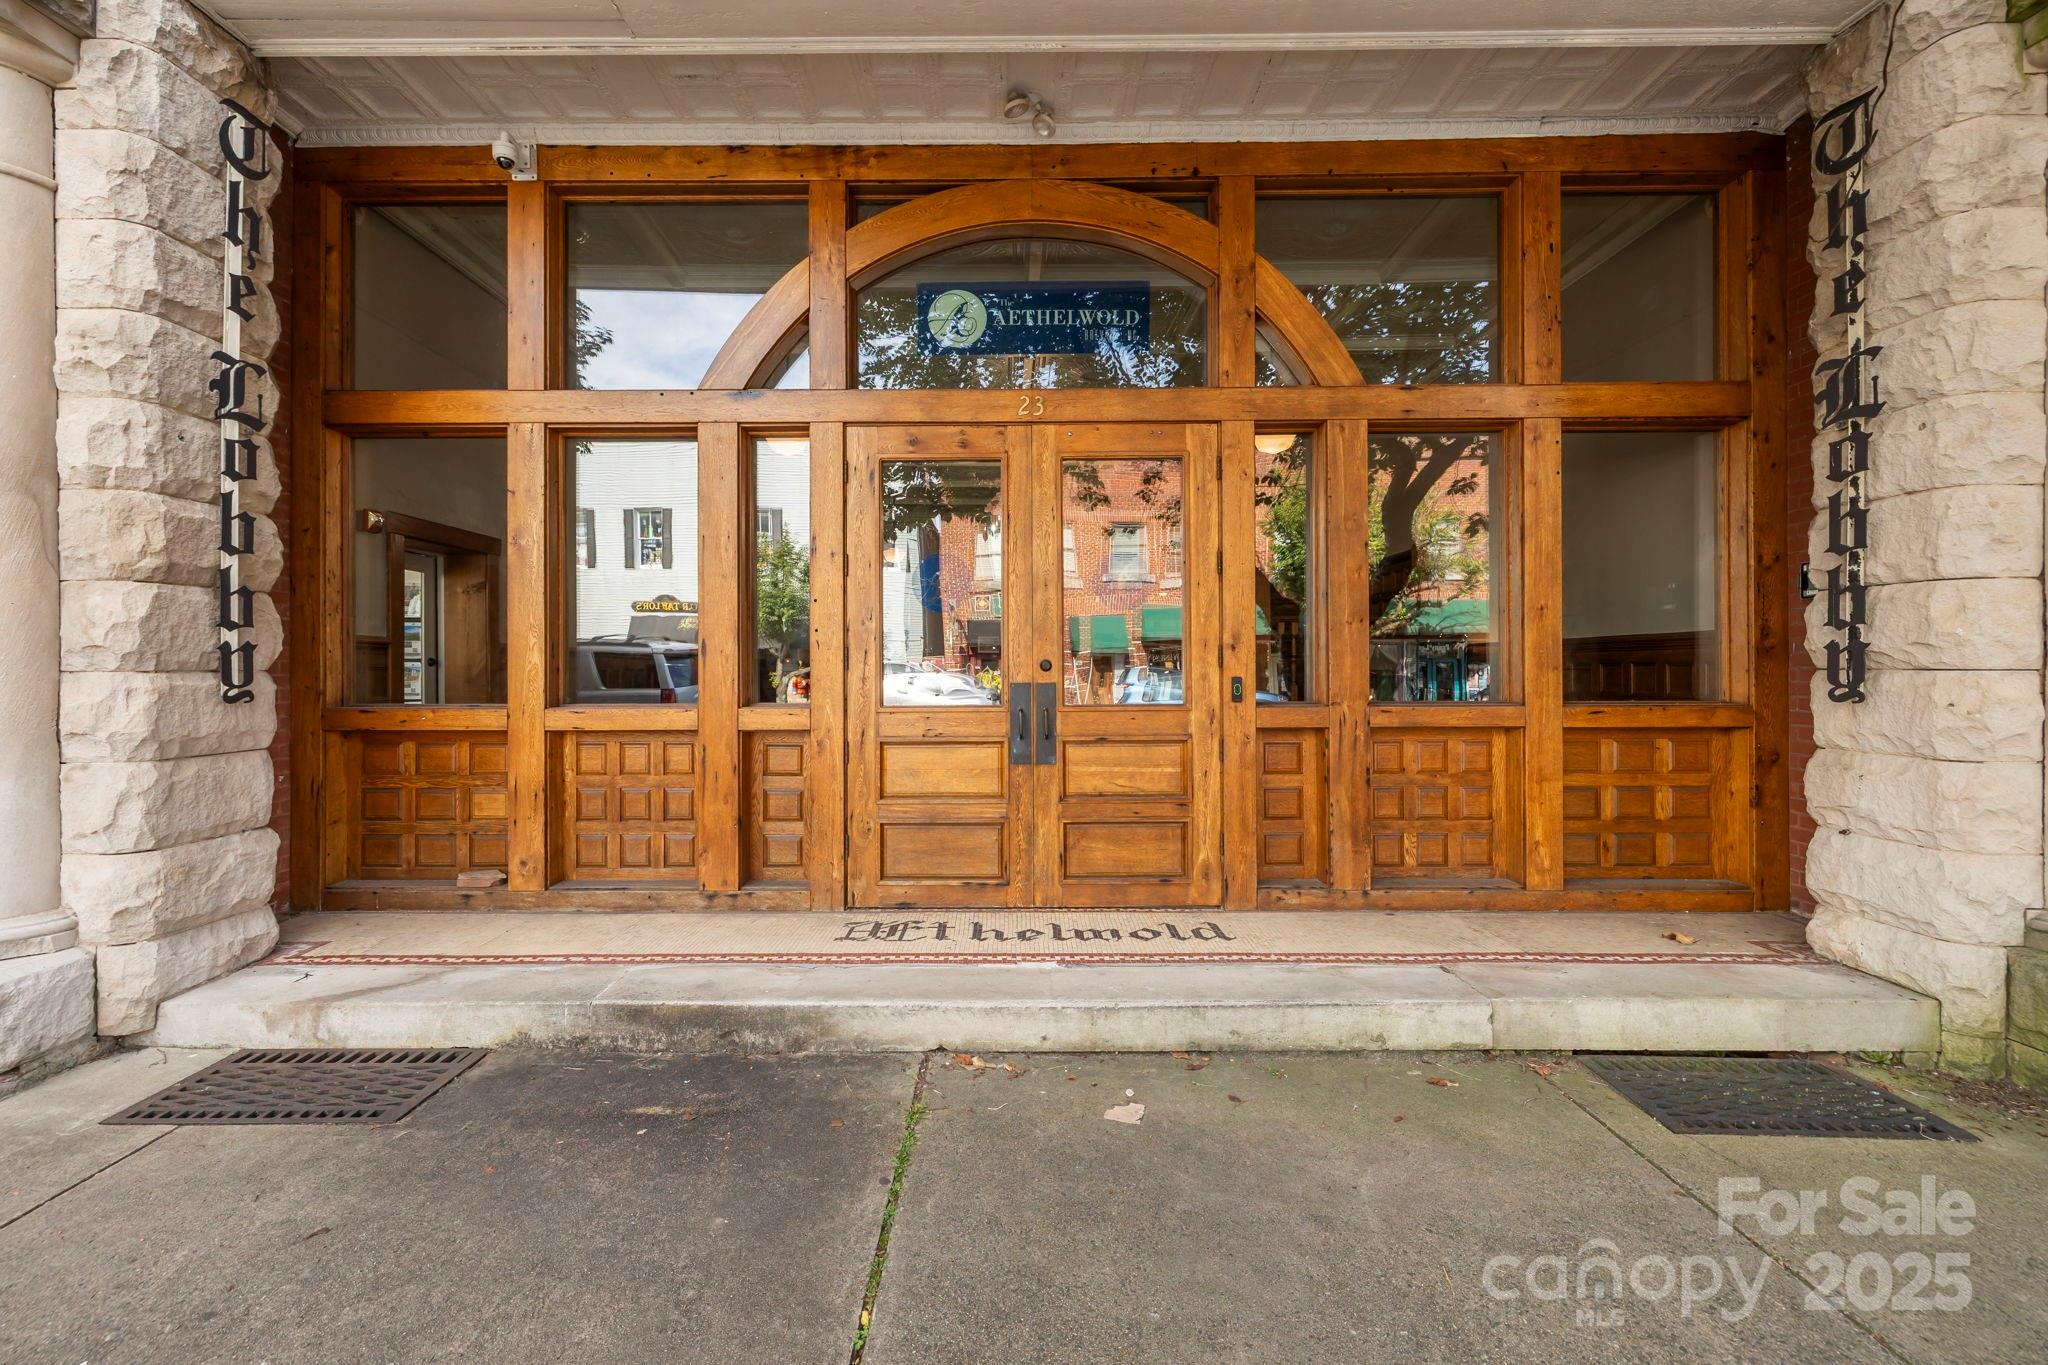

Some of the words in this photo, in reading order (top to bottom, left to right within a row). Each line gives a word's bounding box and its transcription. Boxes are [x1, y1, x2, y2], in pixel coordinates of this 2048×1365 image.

[219, 98, 272, 322] The
[1814, 85, 1879, 317] The
[993, 308, 1140, 326] AETHELWOLD
[1018, 395, 1044, 416] 23
[209, 351, 268, 704] Lobby
[1814, 344, 1887, 703] Lobby
